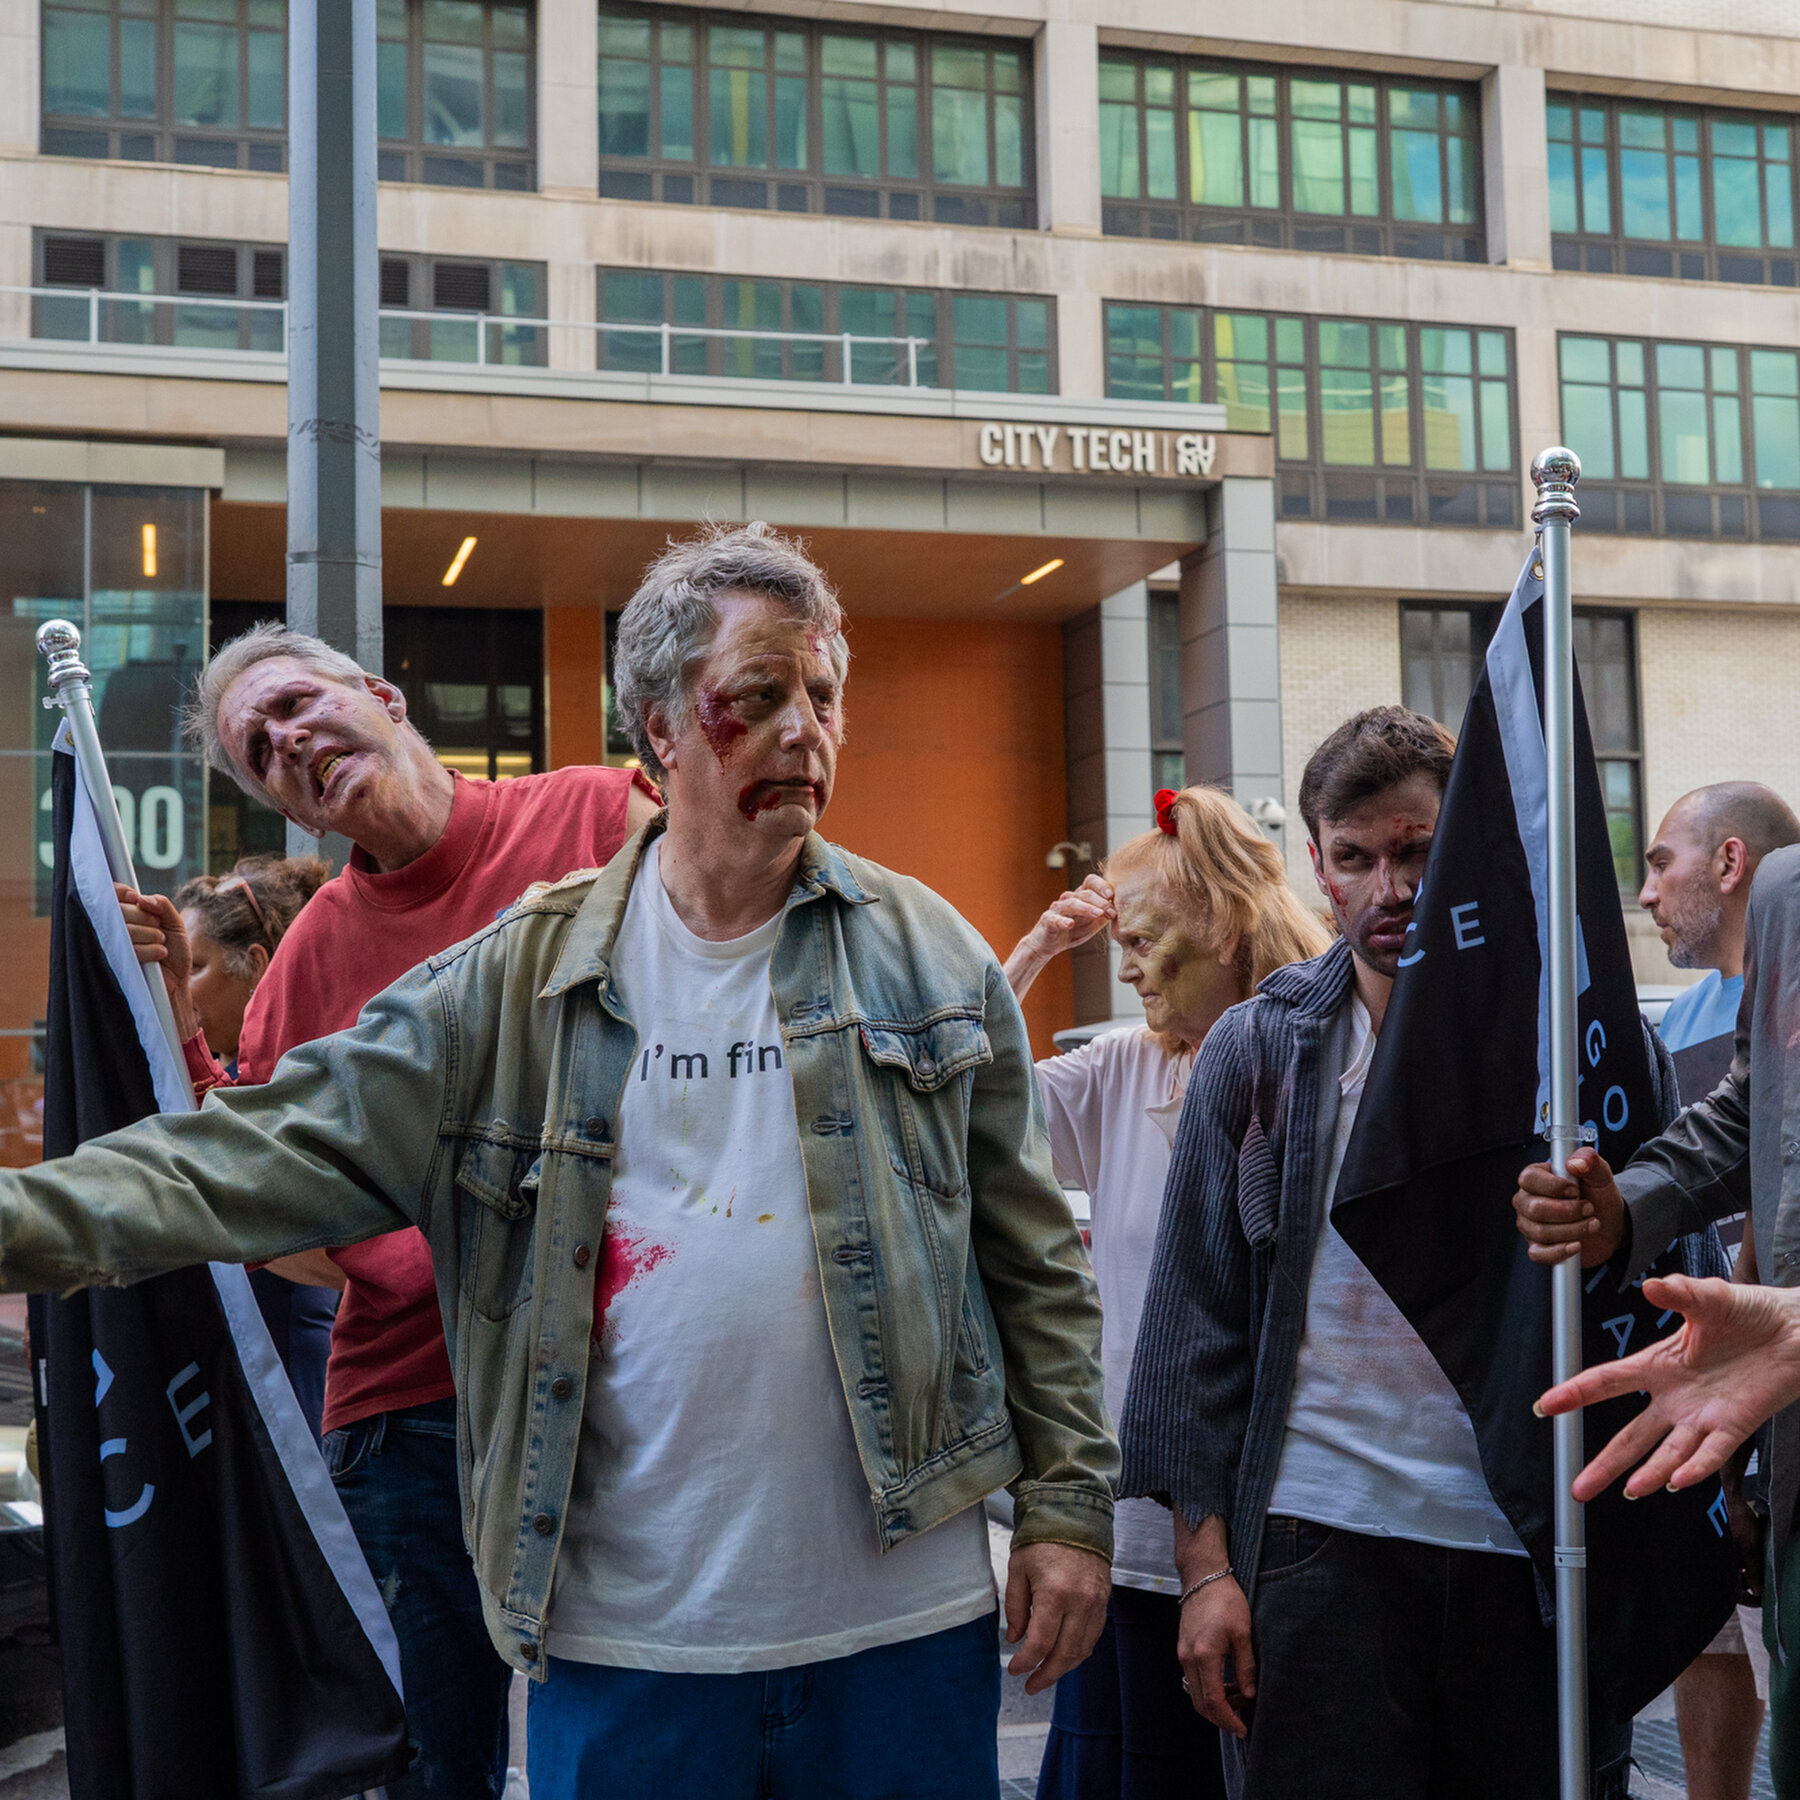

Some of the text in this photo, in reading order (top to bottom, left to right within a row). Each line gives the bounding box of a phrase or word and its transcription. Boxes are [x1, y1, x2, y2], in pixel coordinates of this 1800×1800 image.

[980, 423, 1156, 472] CITY TECH
[641, 1044, 708, 1081] I'm
